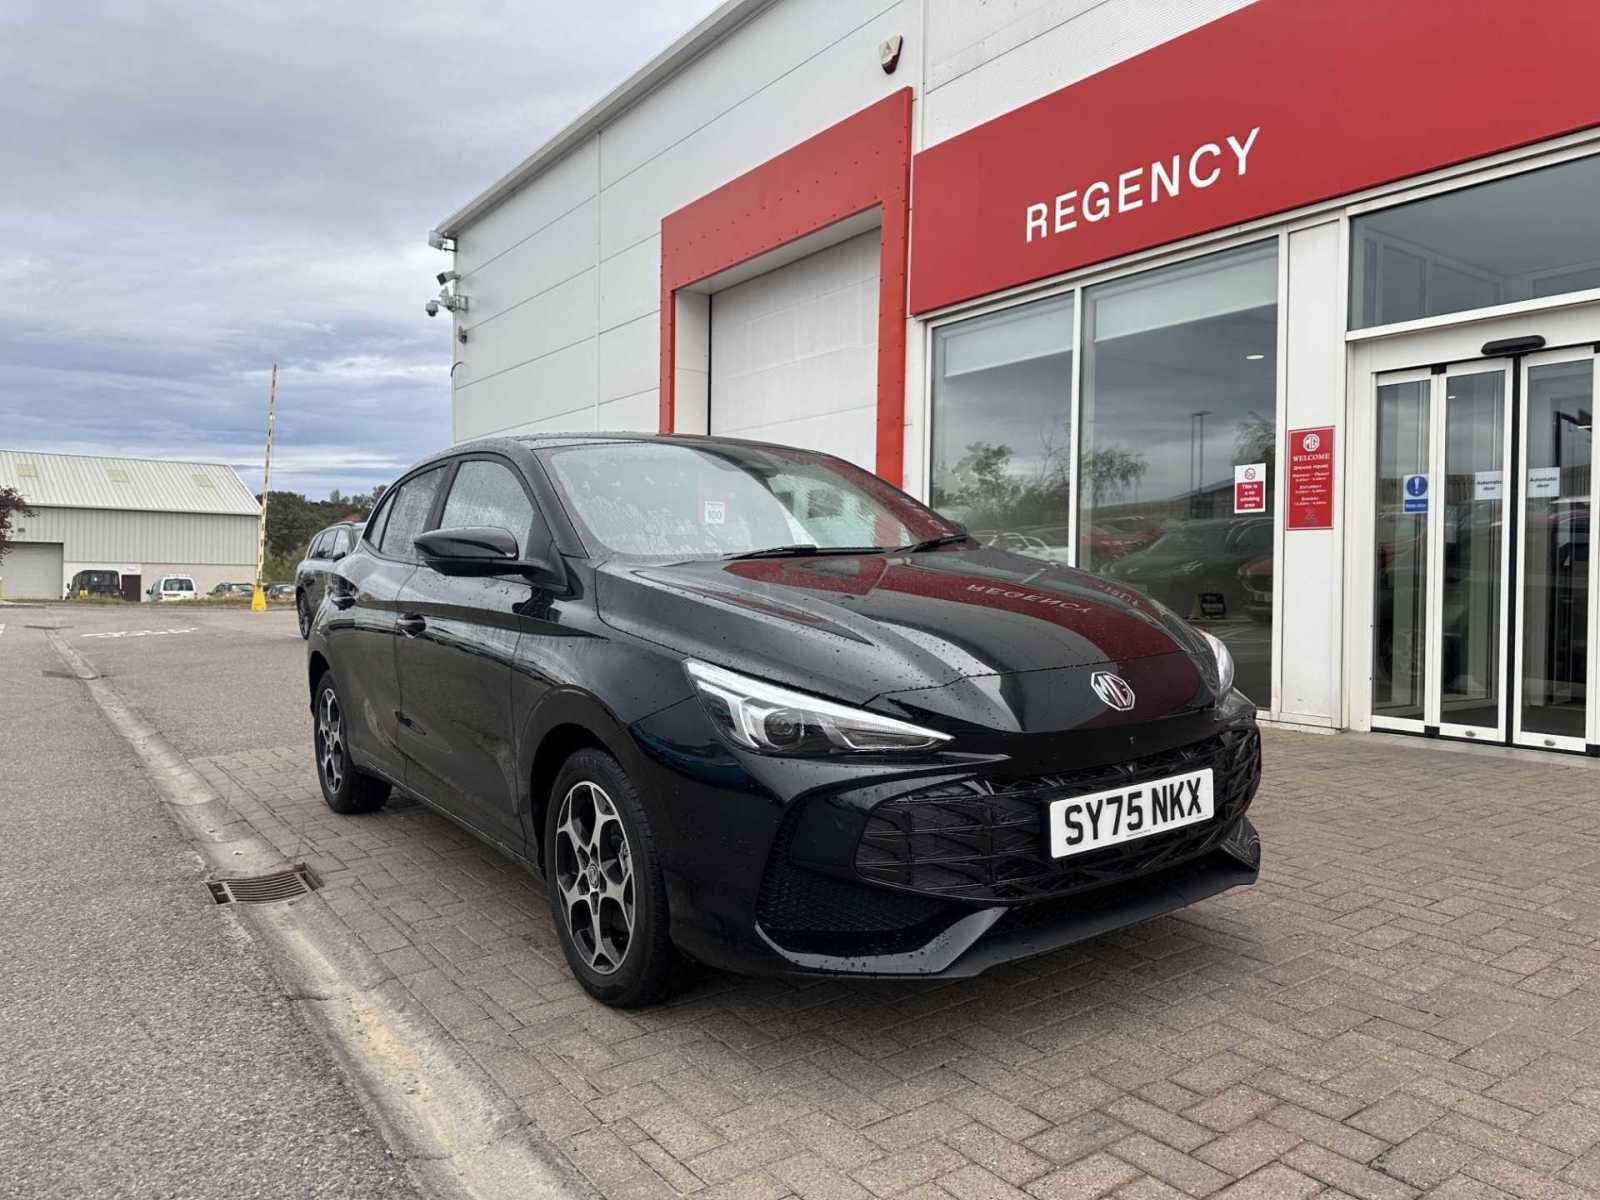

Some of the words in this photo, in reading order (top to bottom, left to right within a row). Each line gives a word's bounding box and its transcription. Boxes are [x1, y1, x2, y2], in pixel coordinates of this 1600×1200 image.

[1026, 127, 1260, 243] REGENCY
[1292, 453, 1330, 462] WELCOME
[1090, 671, 1136, 711] MG
[1065, 790, 1144, 846] SY75
[1151, 777, 1202, 826] NKX
